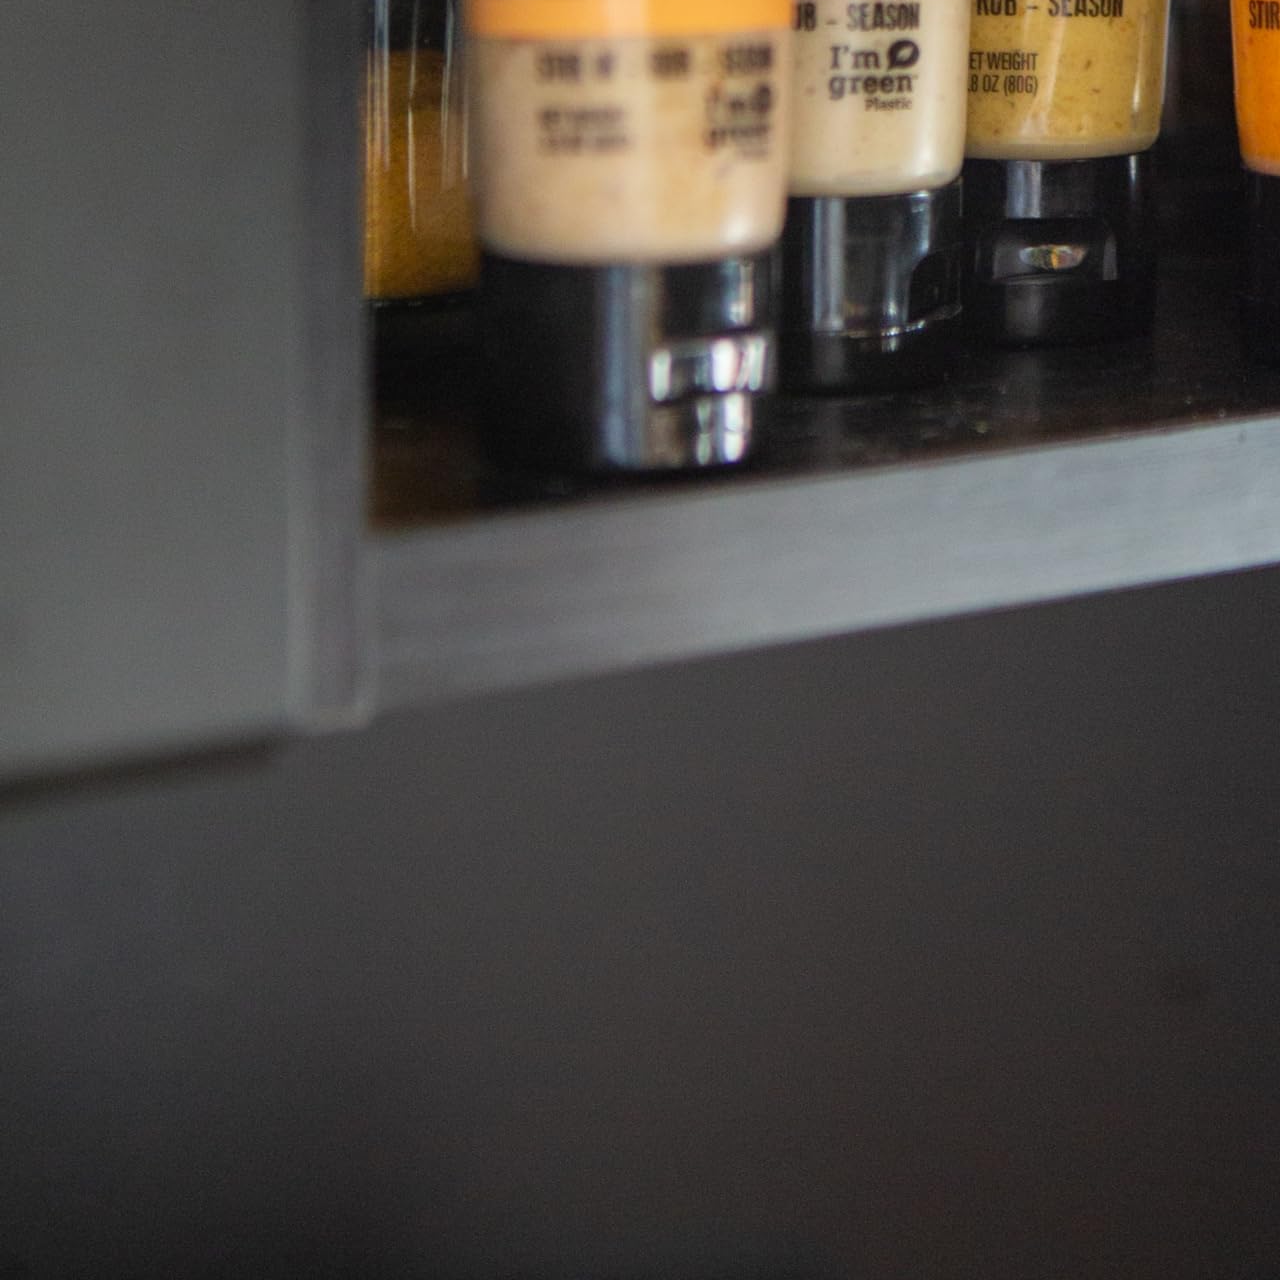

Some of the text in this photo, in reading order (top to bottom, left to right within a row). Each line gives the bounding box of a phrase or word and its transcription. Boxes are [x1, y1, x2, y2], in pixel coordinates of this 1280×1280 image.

[847, 1, 921, 32] SEASON
[1249, 0, 1280, 30] STIR
[830, 44, 881, 69] I'm
[968, 51, 1039, 71] ET WEIGHT
[828, 73, 913, 101] green
[983, 74, 1000, 94] OZ
[1003, 74, 1039, 97] (80G)
